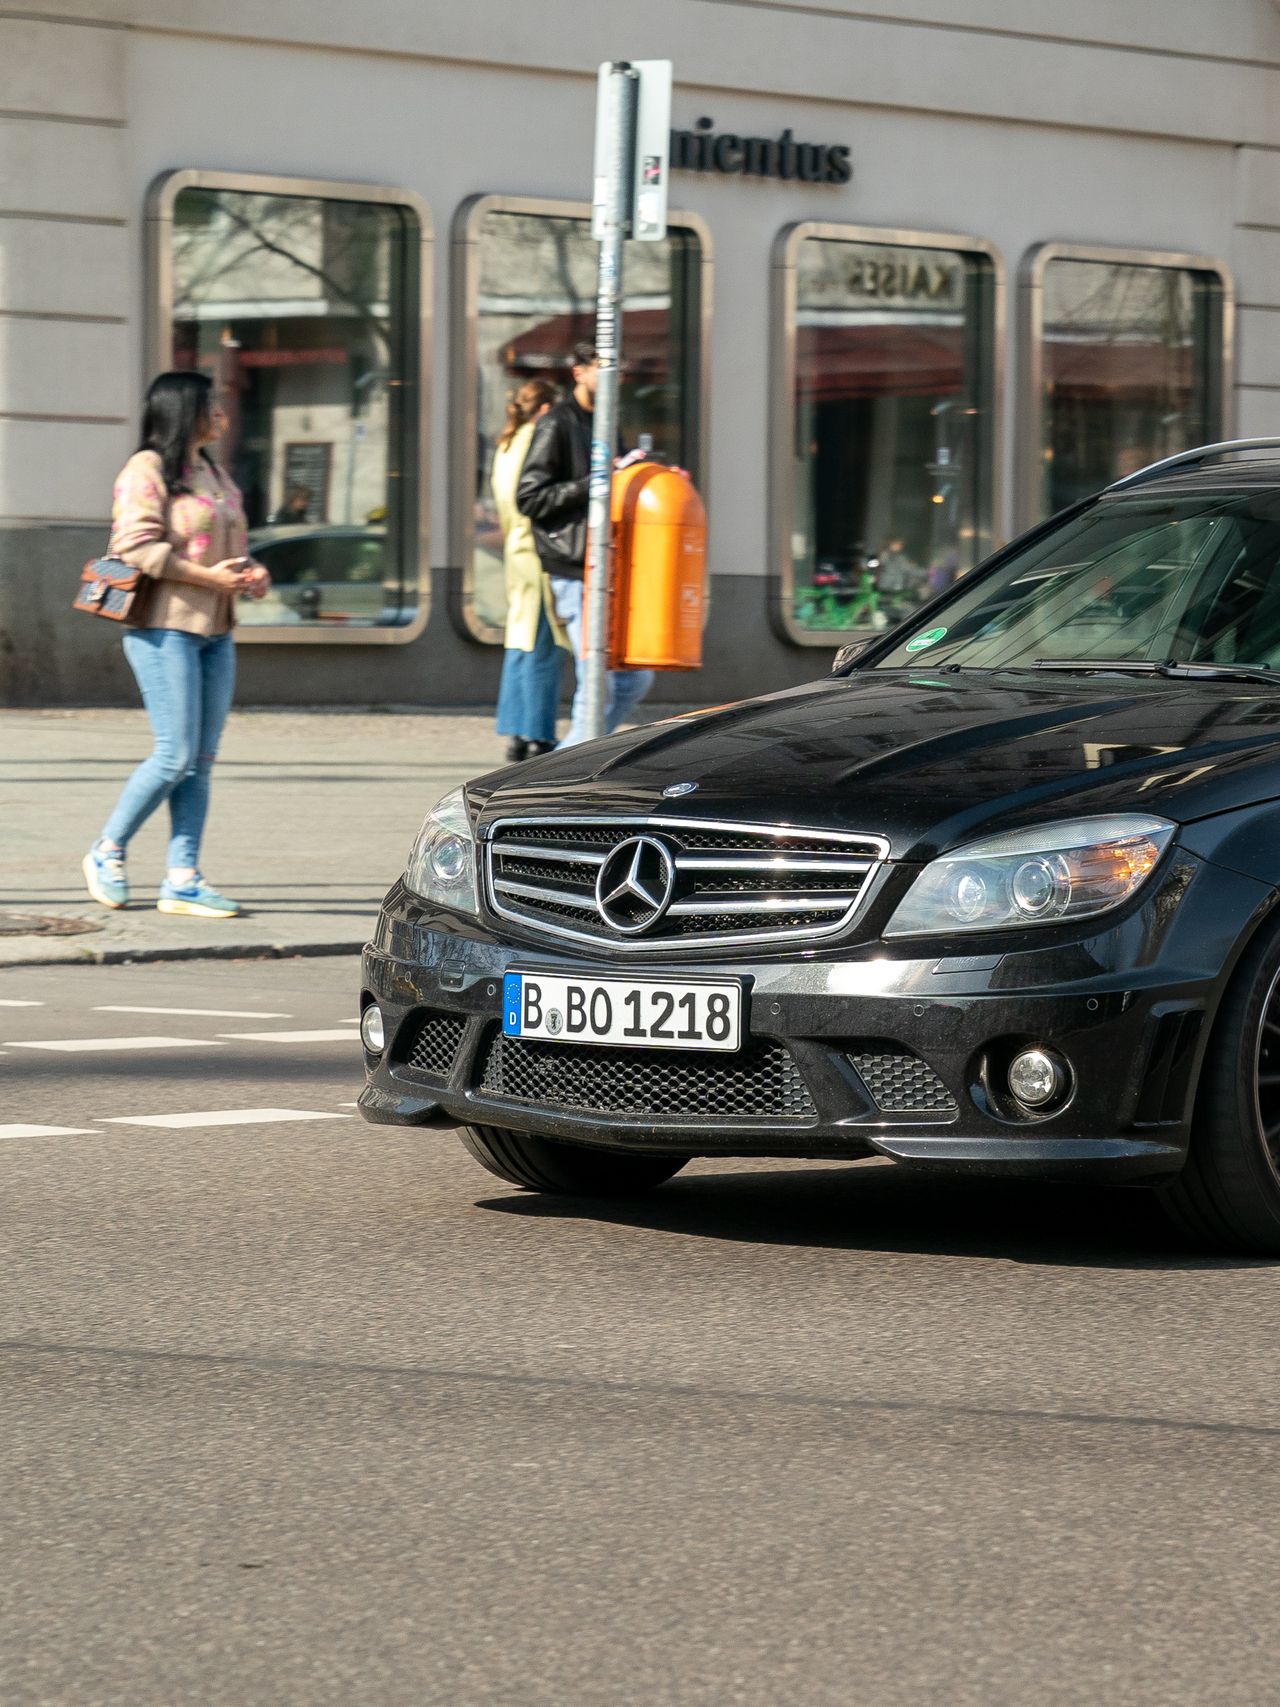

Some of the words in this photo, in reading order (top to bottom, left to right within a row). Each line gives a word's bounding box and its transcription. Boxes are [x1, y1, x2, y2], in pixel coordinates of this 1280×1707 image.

[509, 1011, 517, 1025] D
[523, 982, 542, 1030] B
[566, 985, 613, 1036] BO
[623, 989, 731, 1041] 1218
